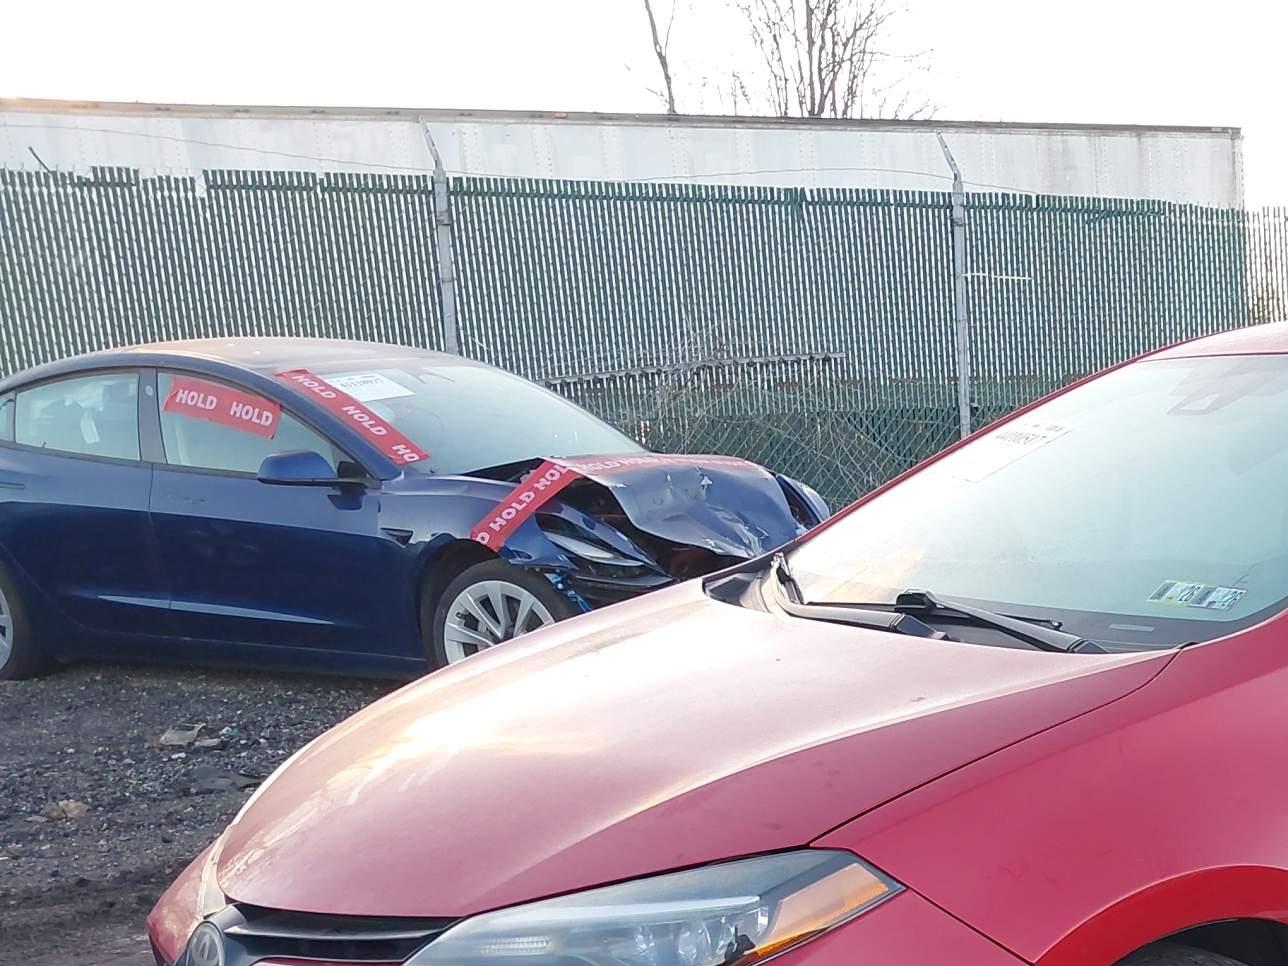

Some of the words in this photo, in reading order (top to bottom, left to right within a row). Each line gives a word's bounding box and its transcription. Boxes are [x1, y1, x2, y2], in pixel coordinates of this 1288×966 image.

[175, 388, 217, 410] HOLD
[229, 401, 273, 426] HOLD
[291, 375, 337, 399] HOLD
[342, 405, 388, 436] HOLD
[489, 491, 536, 532] HOLD
